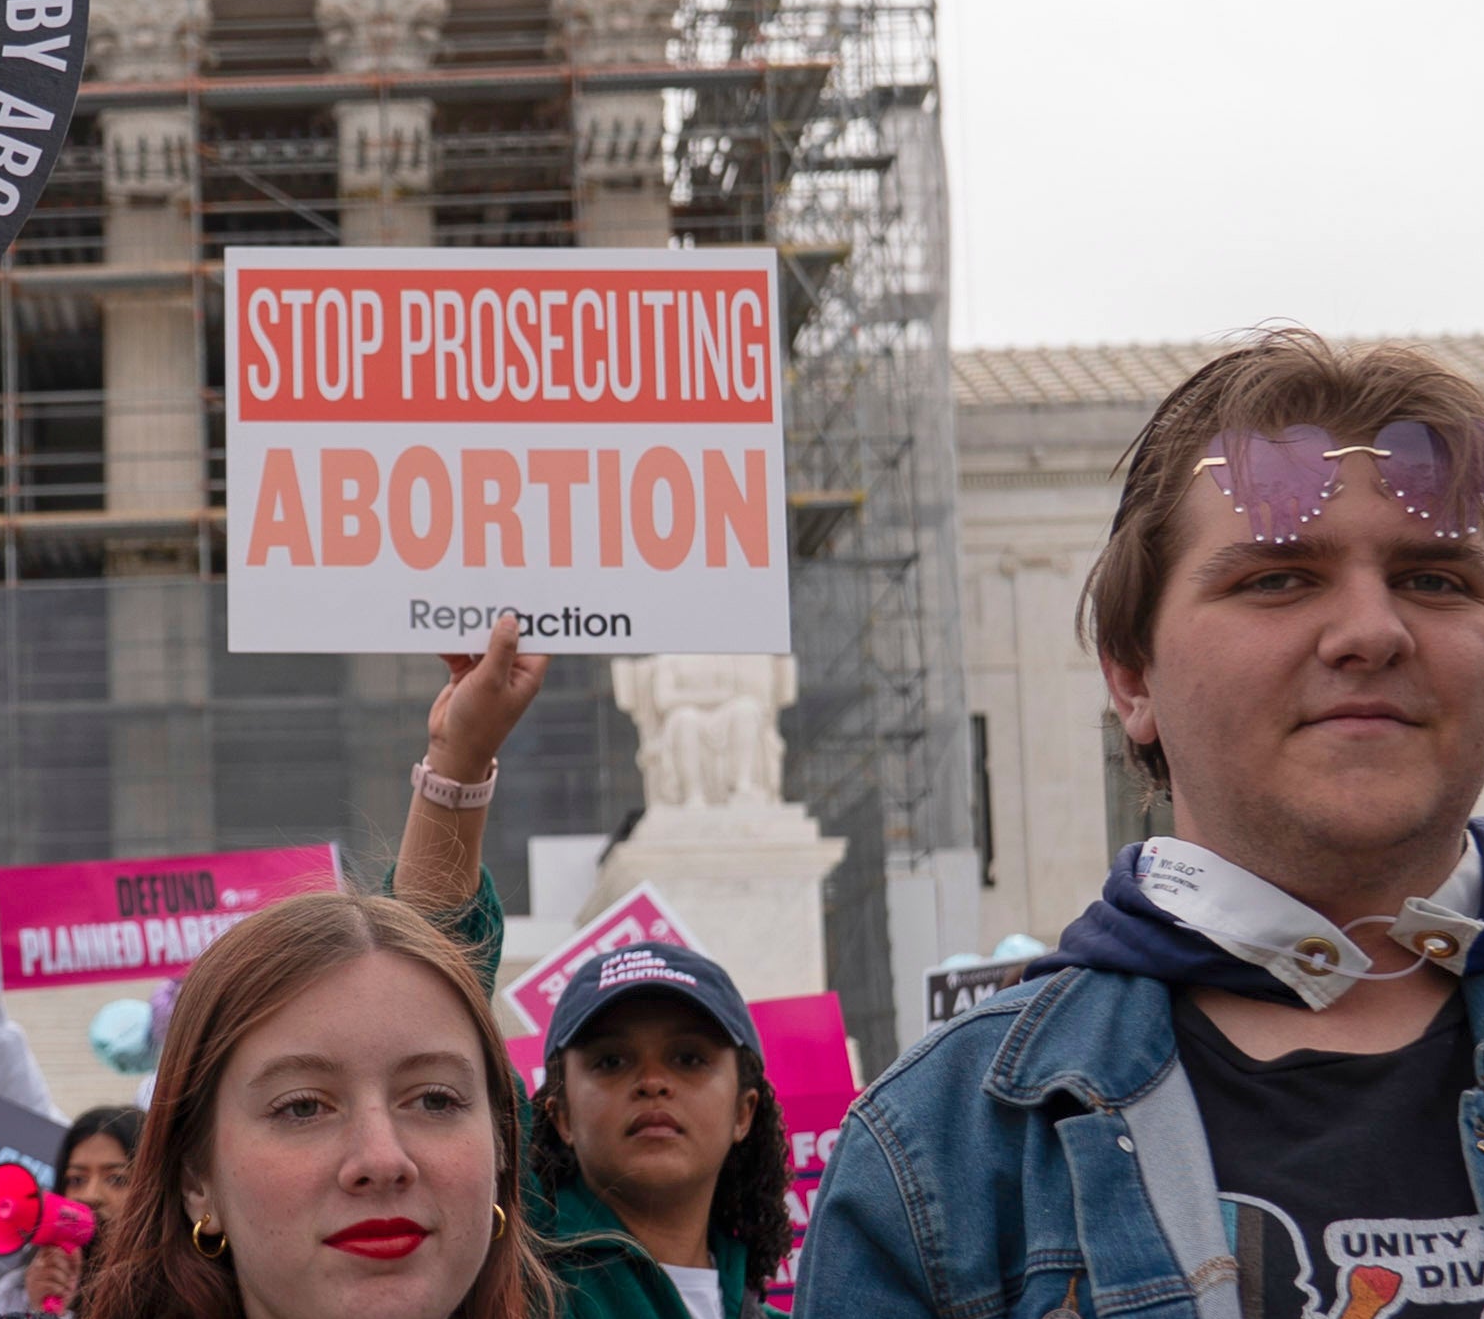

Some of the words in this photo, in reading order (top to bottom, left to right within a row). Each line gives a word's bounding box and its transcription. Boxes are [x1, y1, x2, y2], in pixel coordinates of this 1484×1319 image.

[247, 287, 384, 401] STOP
[400, 287, 766, 403] PROSECUTING
[245, 445, 770, 572] ABORTION
[115, 871, 217, 917] DEFUND
[19, 920, 144, 977] PLANNED
[1342, 1229, 1467, 1258] UNITY
